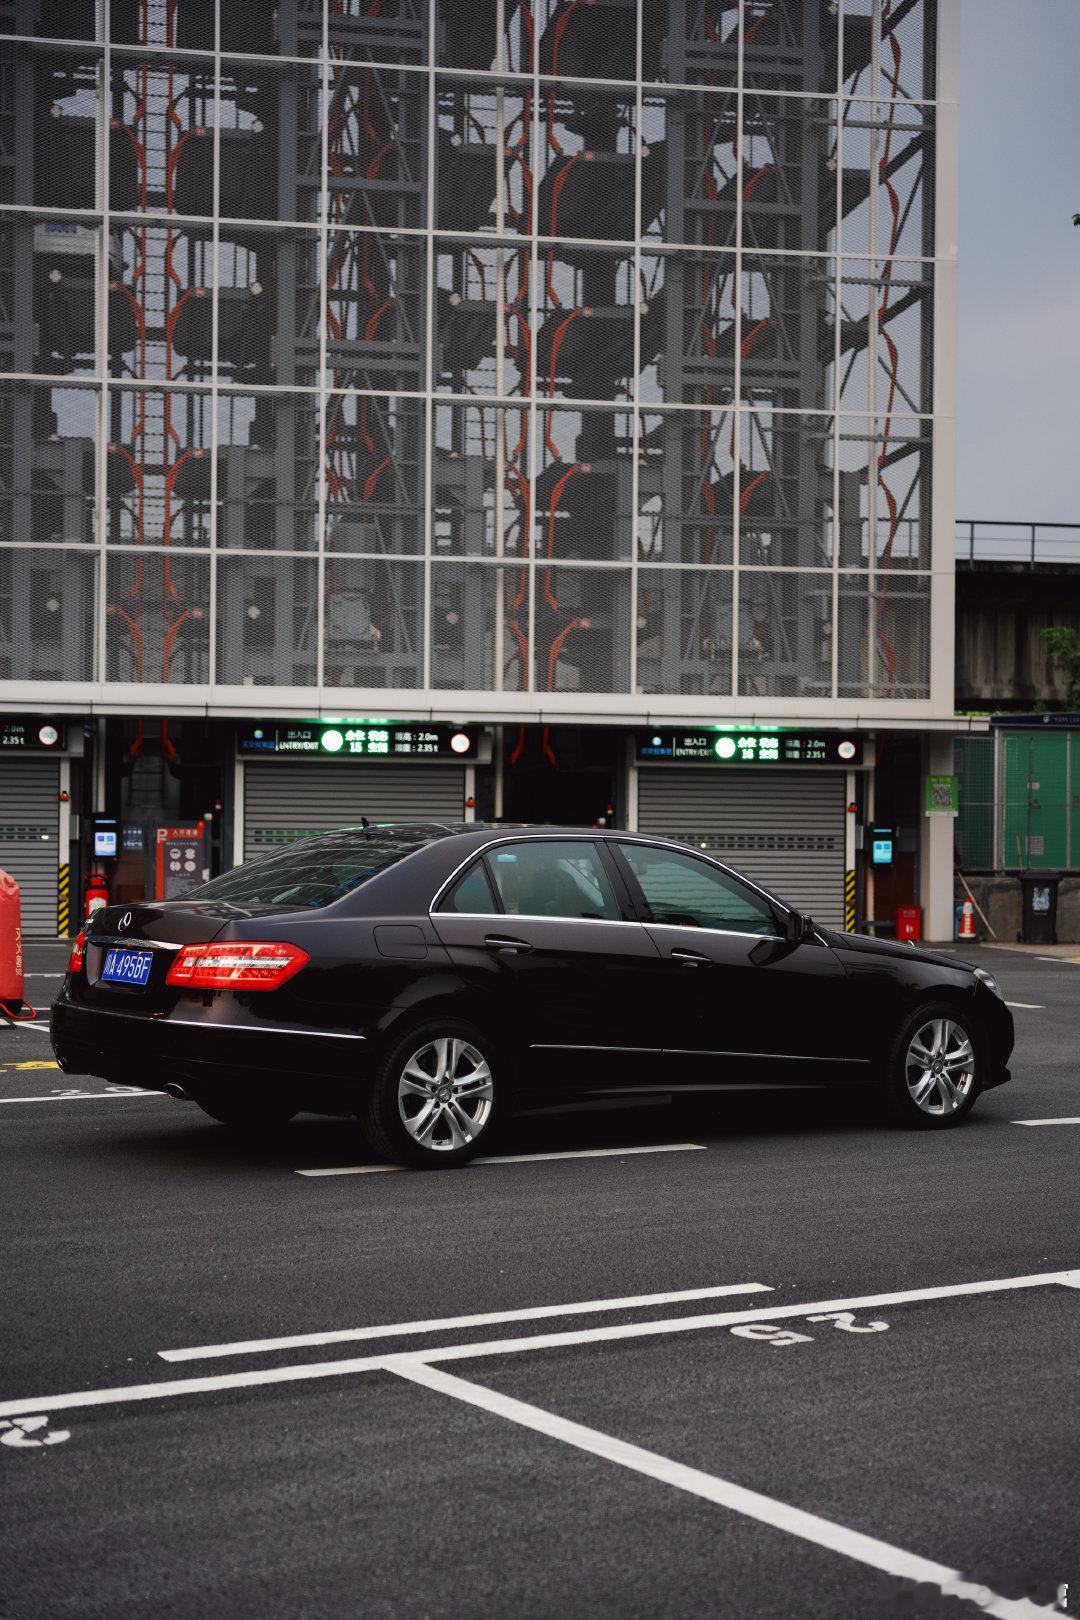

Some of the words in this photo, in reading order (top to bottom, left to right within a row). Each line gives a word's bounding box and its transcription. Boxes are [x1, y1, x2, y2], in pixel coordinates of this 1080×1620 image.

[287, 730, 312, 739] 出入口
[683, 737, 707, 746] 出入口
